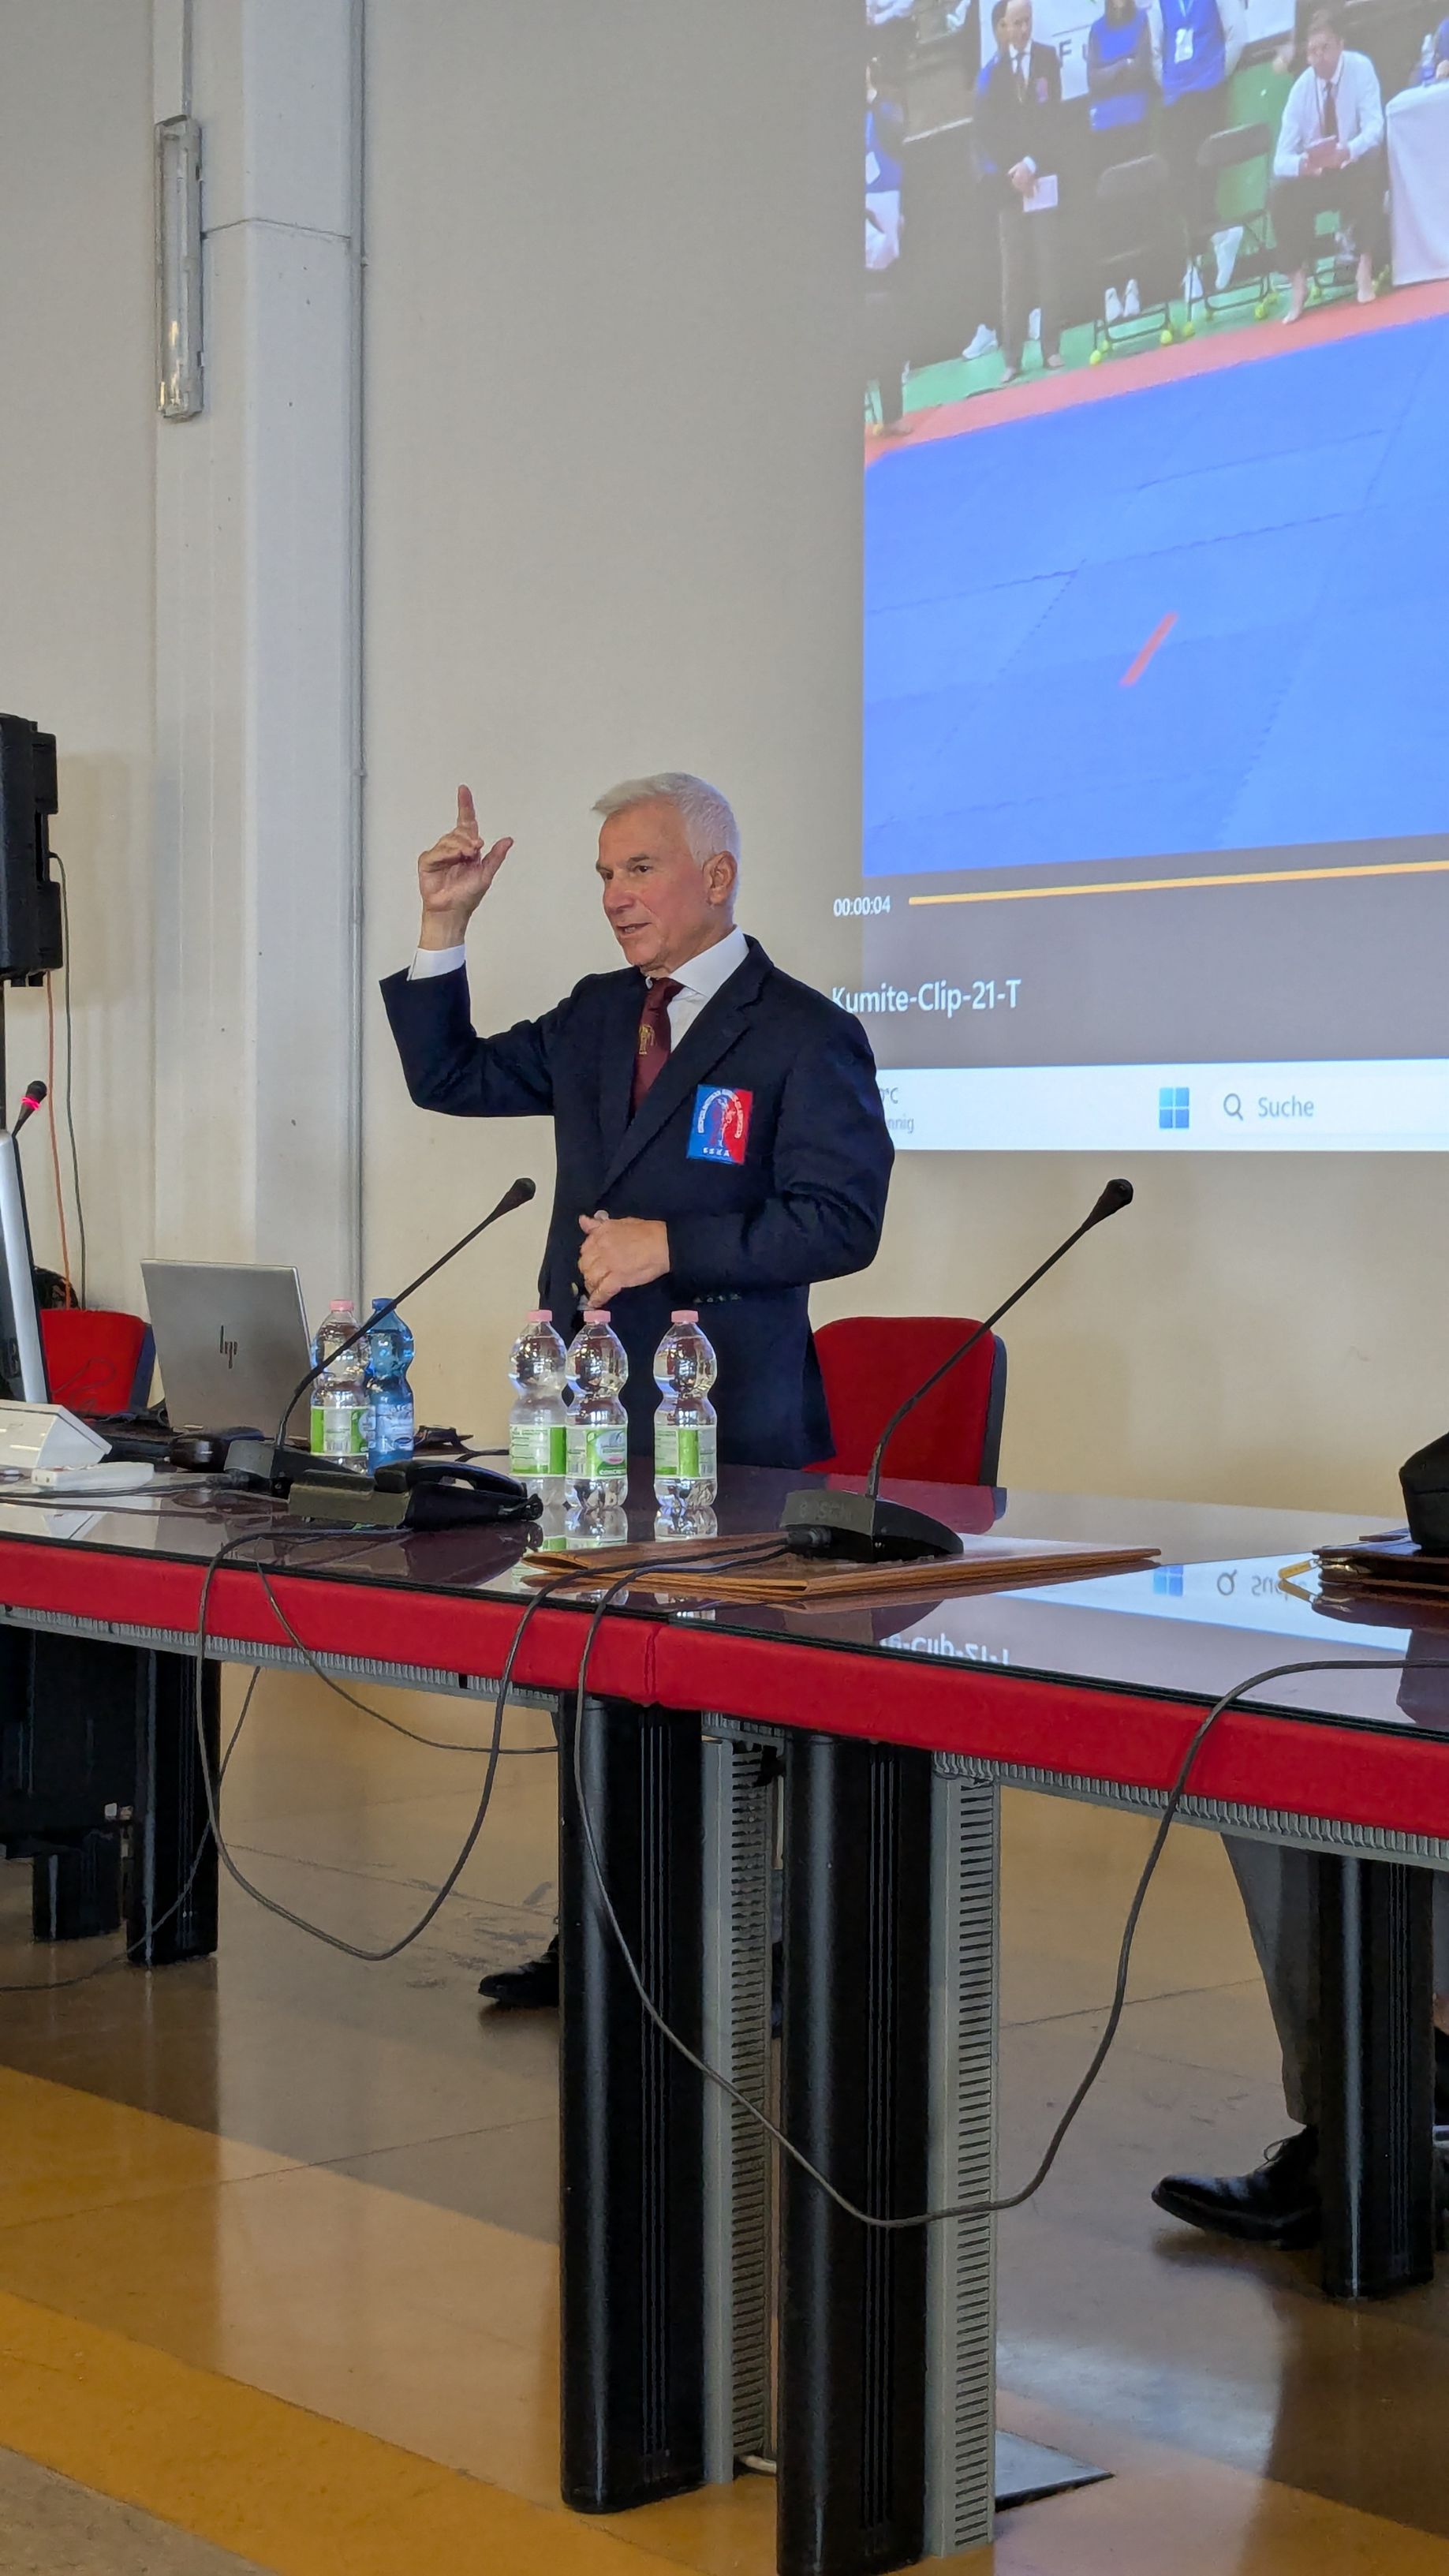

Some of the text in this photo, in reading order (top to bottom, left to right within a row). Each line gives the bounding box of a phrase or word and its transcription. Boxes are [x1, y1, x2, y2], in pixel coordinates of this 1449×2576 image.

[833, 895, 891, 917] 00:00:04
[832, 979, 1022, 1019] Kumite-Clip-21-T
[1258, 1095, 1314, 1117] Suche
[220, 1325, 237, 1370] hp
